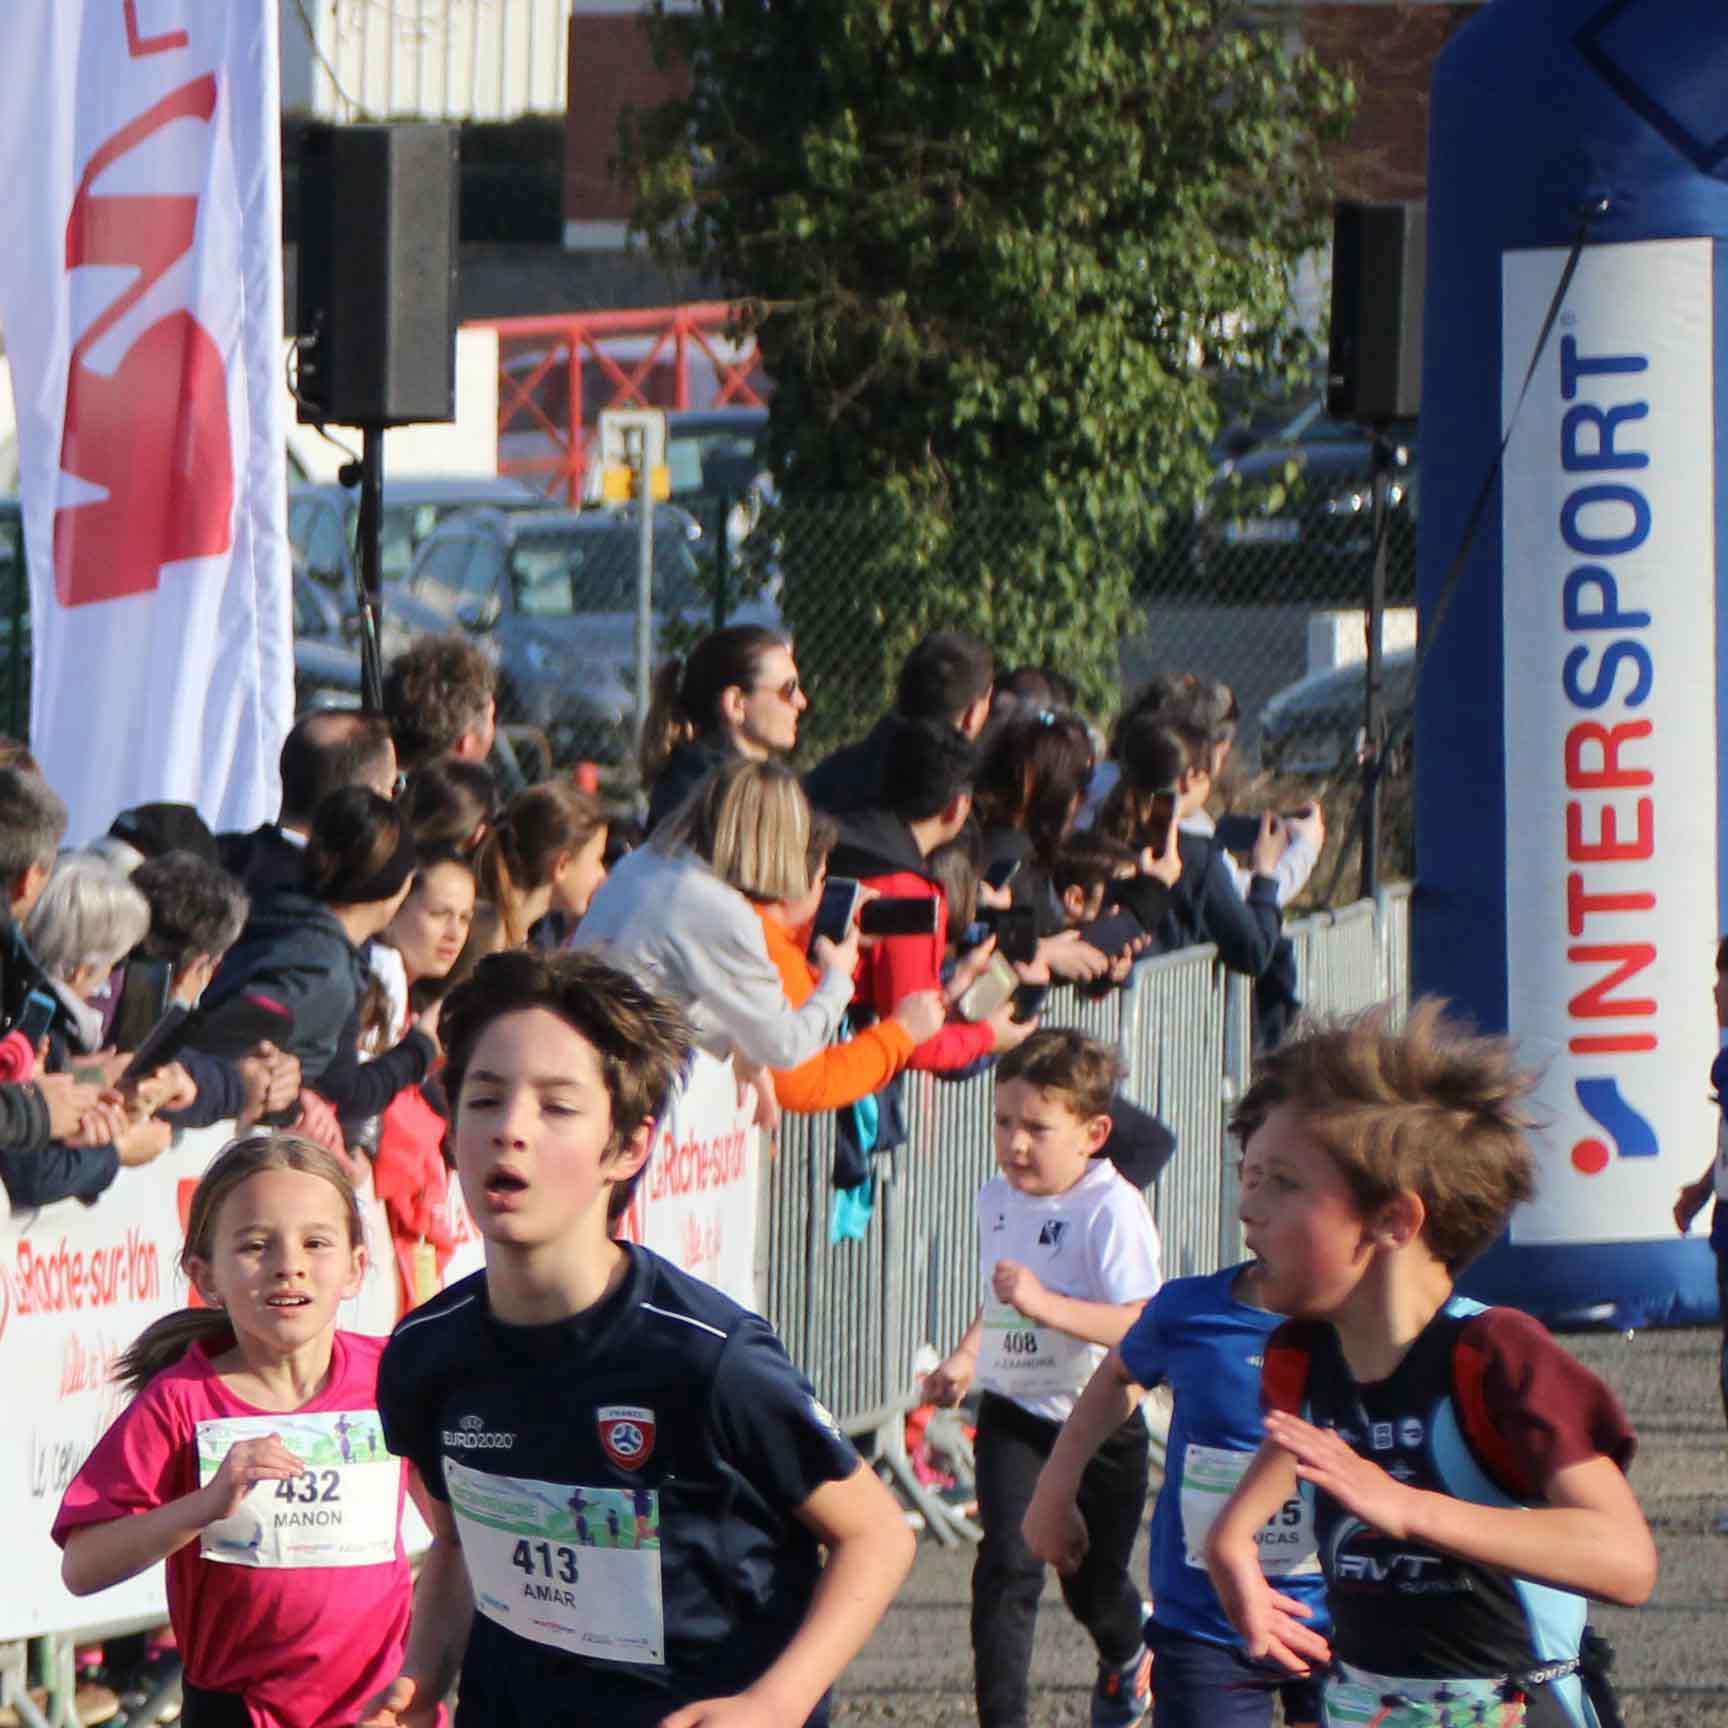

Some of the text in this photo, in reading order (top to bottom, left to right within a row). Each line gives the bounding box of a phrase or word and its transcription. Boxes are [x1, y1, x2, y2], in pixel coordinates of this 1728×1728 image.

[1558, 334, 1658, 1055] INTERSPORT
[274, 1469, 341, 1504] 432
[273, 1510, 343, 1530] MANON
[1252, 1531, 1300, 1545] UCAS
[512, 1539, 580, 1585] 413
[523, 1582, 577, 1609] AMAR
